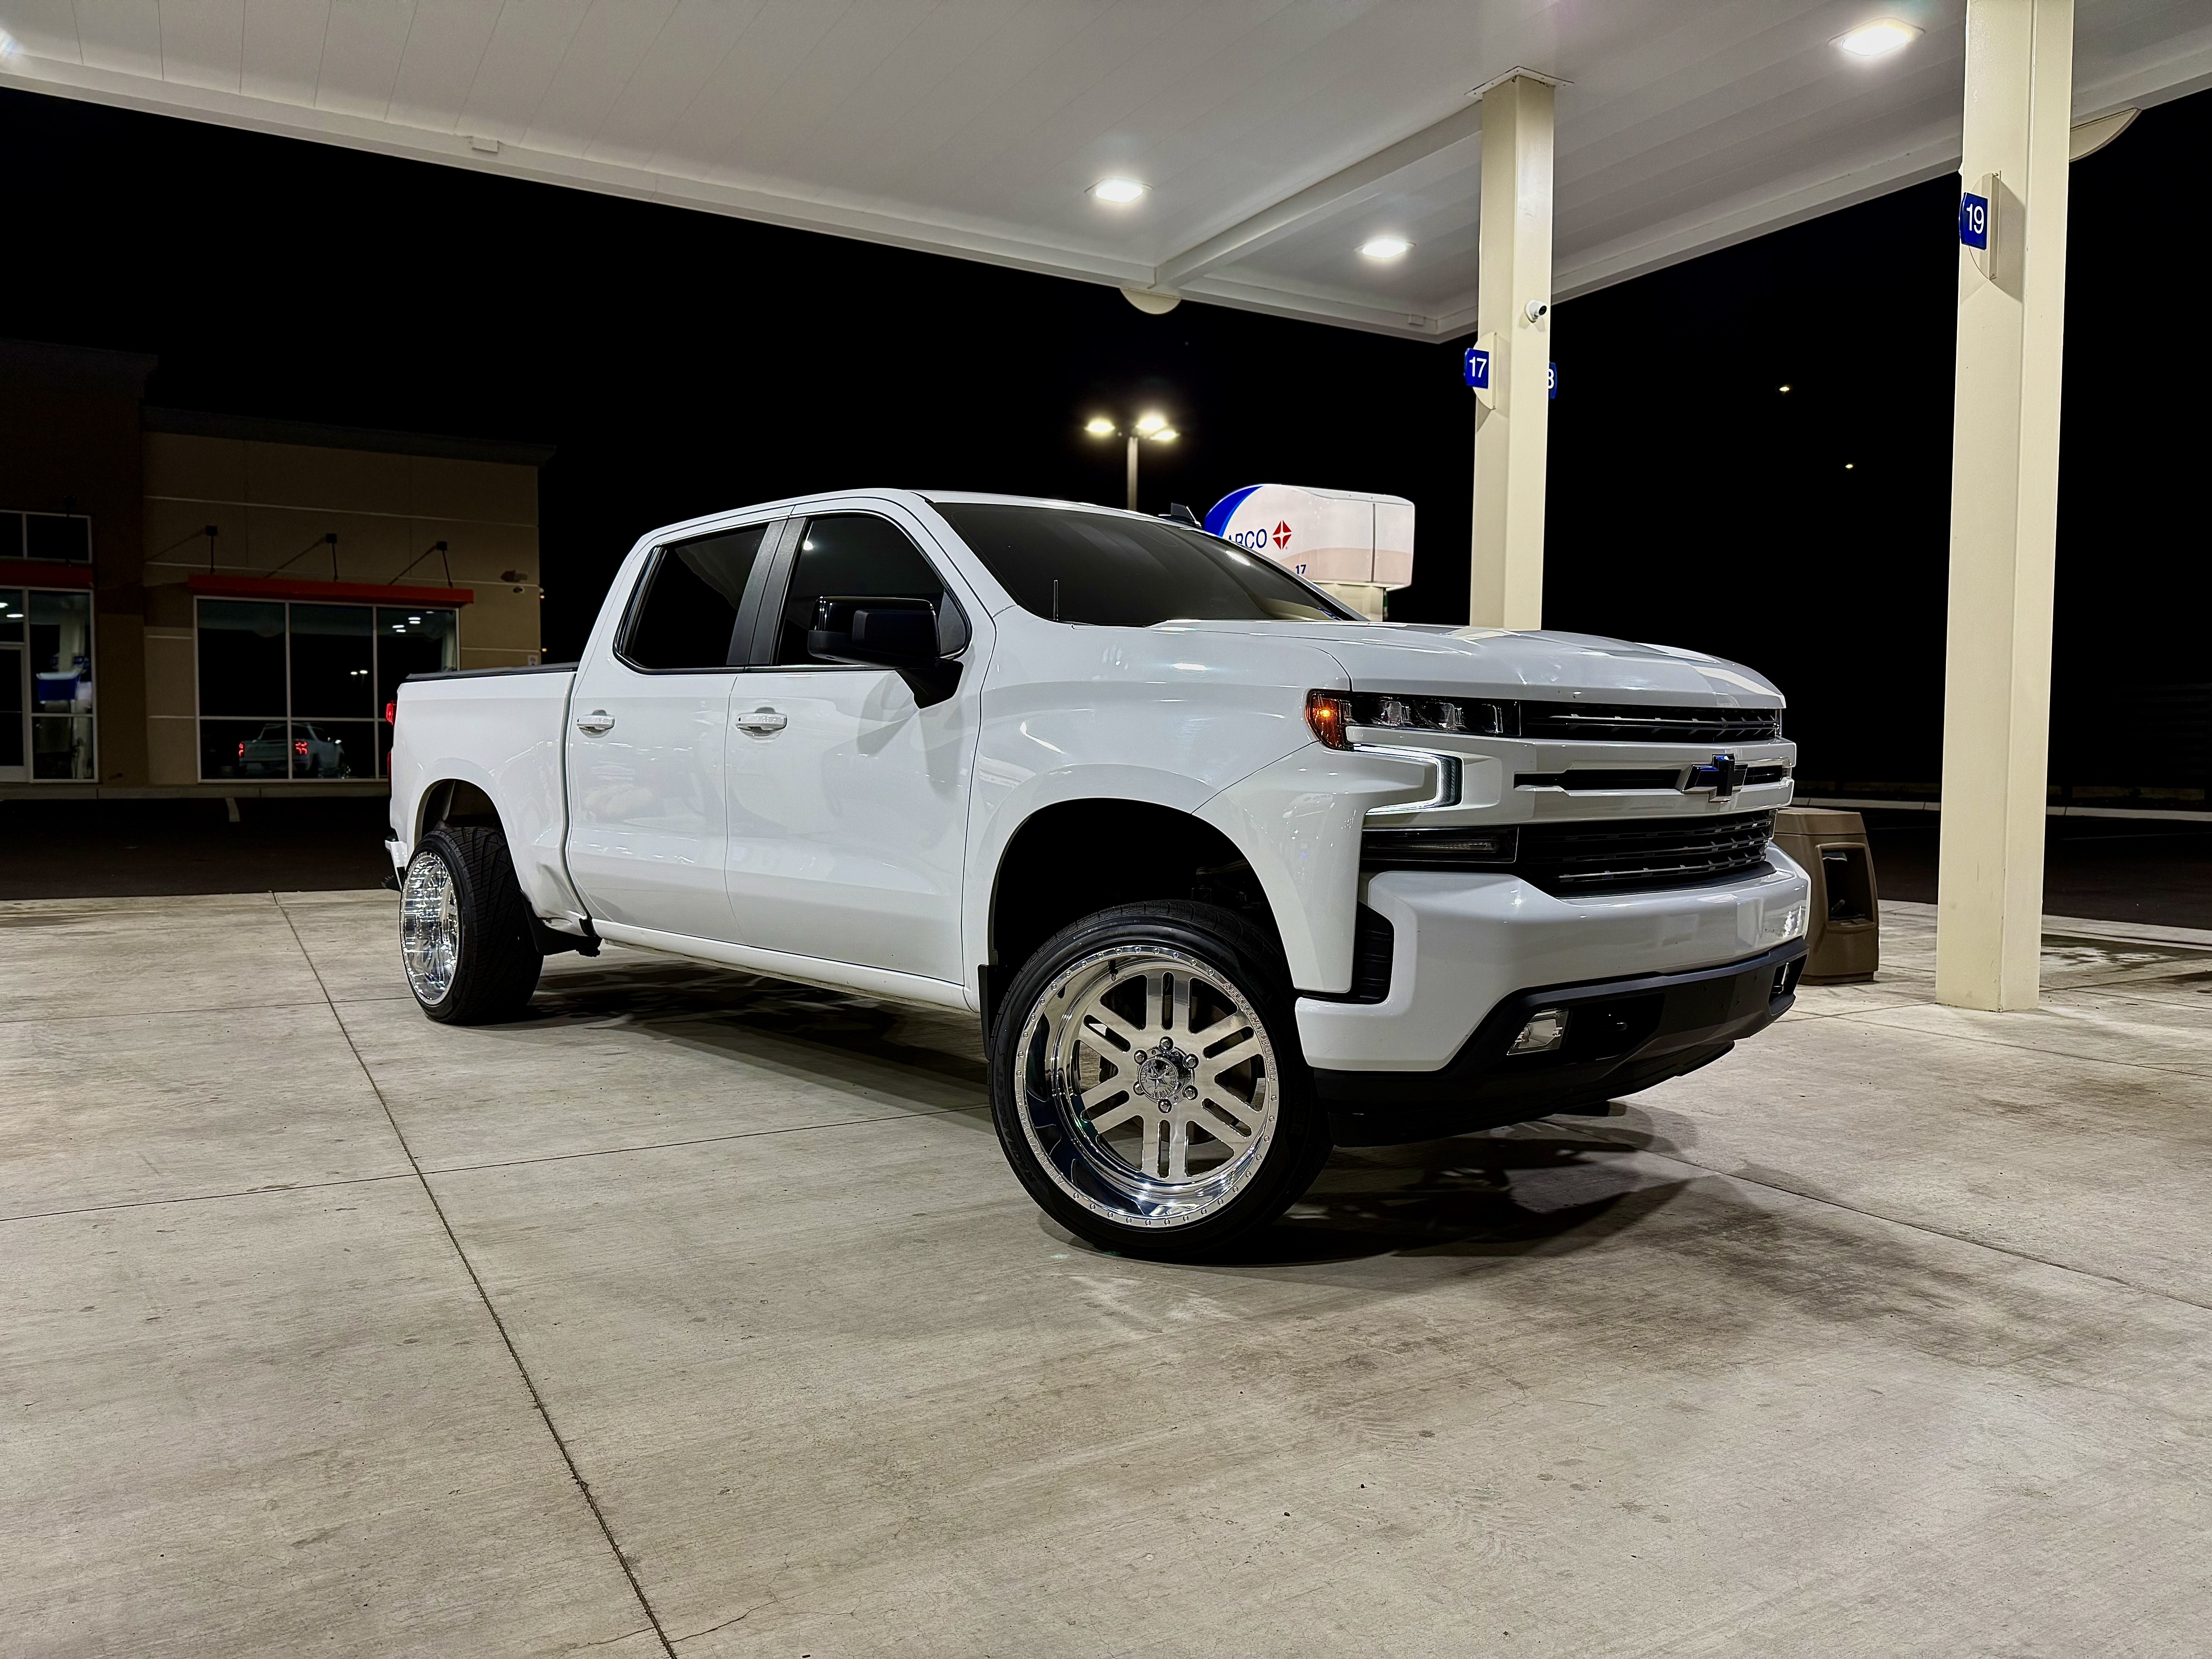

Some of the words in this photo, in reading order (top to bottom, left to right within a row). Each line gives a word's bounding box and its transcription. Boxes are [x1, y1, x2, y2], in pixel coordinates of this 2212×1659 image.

[1966, 204, 1984, 234] 19
[1469, 356, 1487, 378] 17
[1295, 564, 1307, 574] 17
